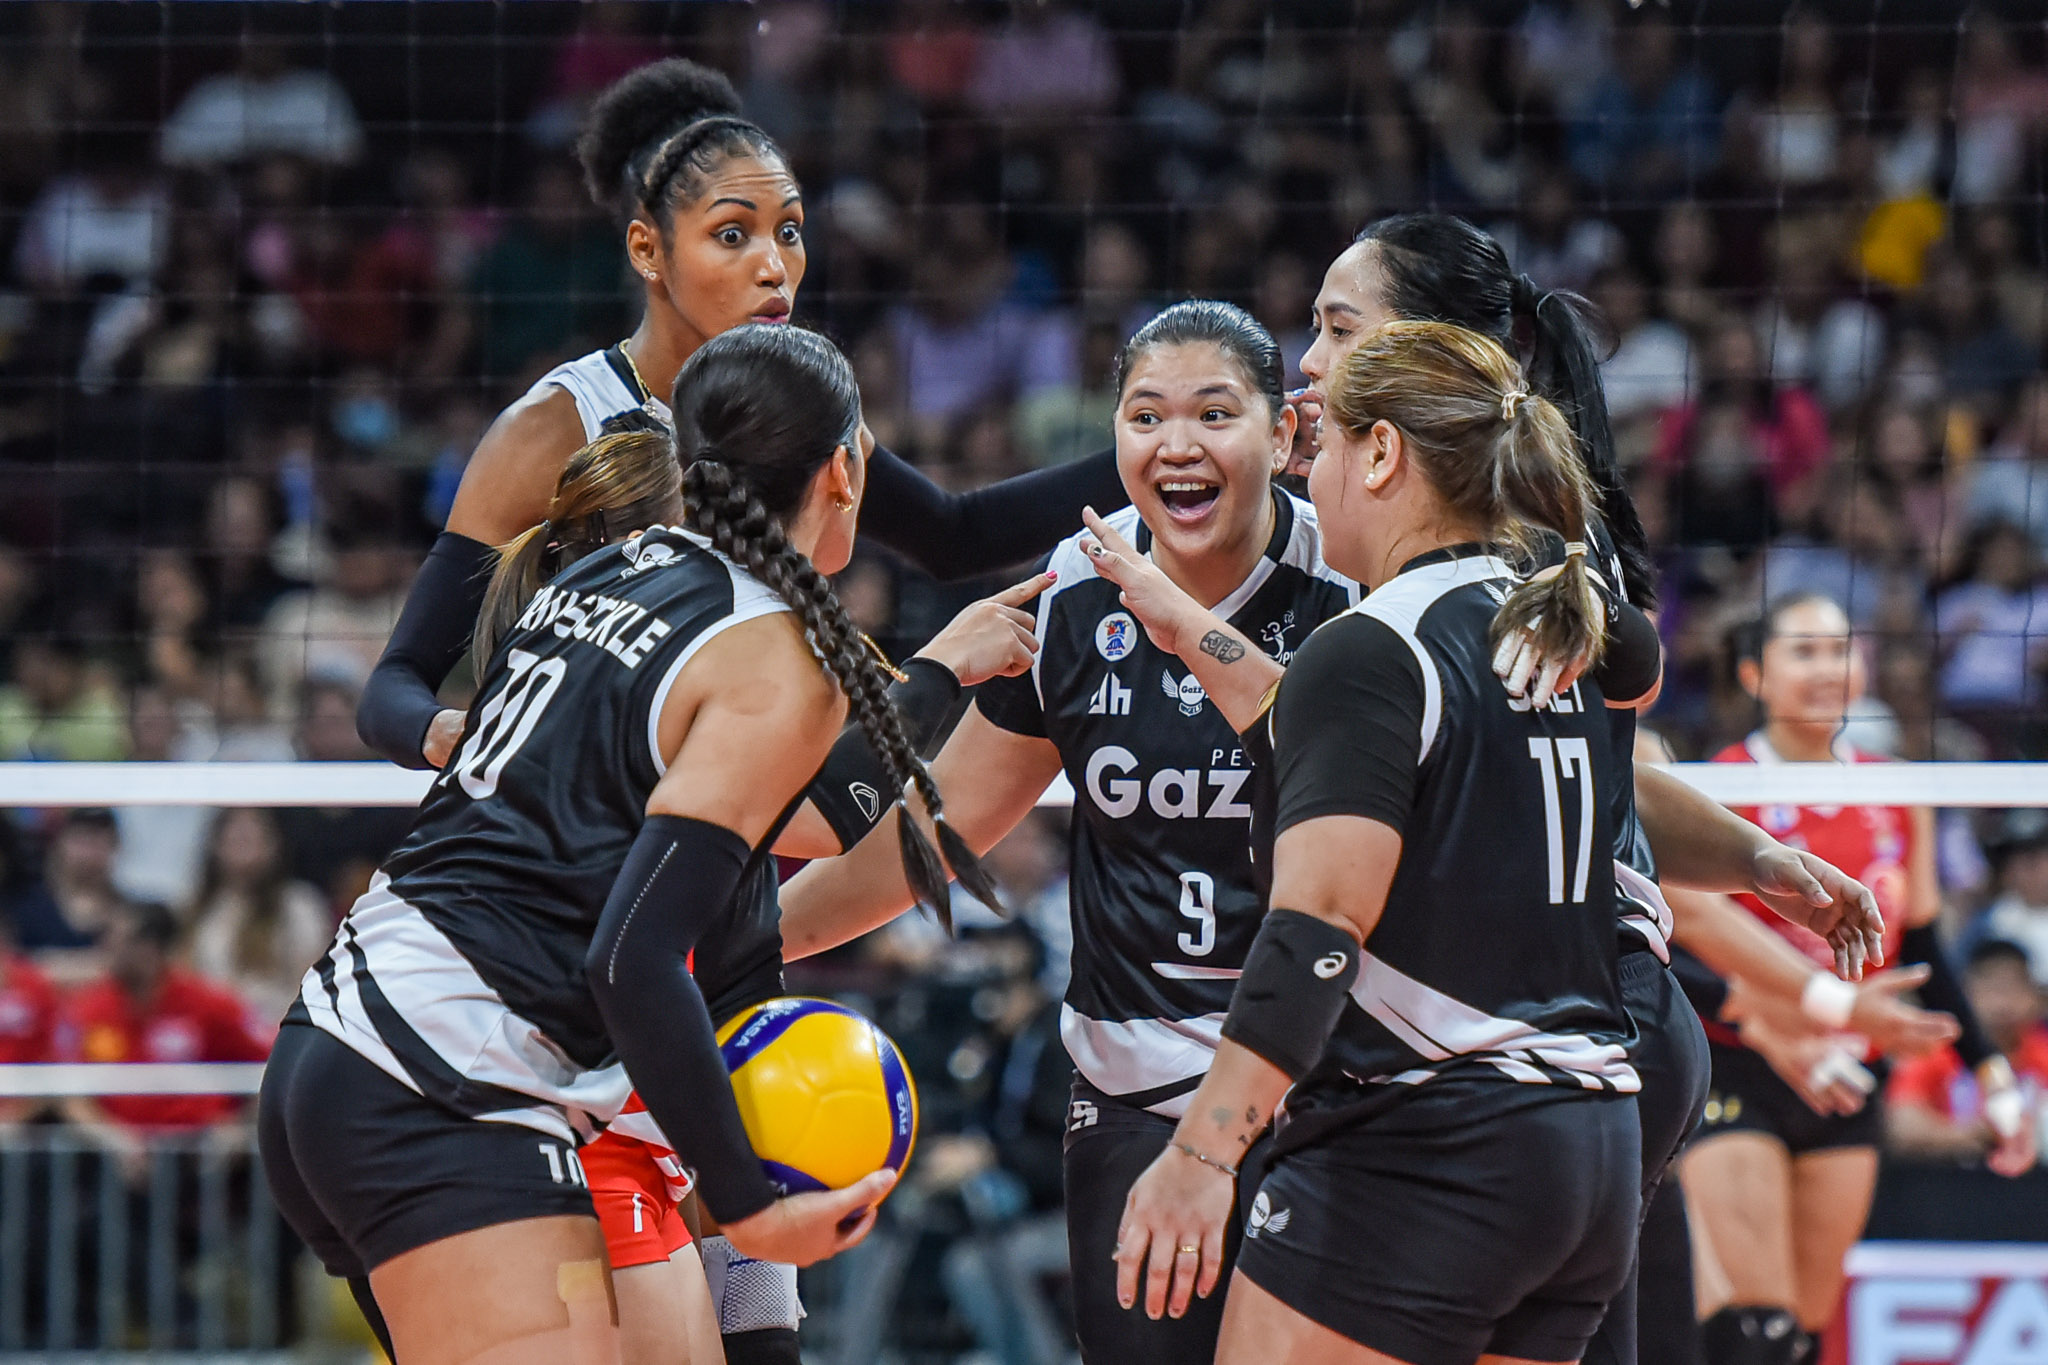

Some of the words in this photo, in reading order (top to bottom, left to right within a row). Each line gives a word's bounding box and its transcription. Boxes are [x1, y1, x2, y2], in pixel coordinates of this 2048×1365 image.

[438, 648, 568, 799] 10
[1211, 749, 1255, 767] PE
[1528, 737, 1595, 904] 17
[1177, 871, 1216, 957] 9
[538, 1143, 589, 1189] 10
[631, 1193, 643, 1233] 1
